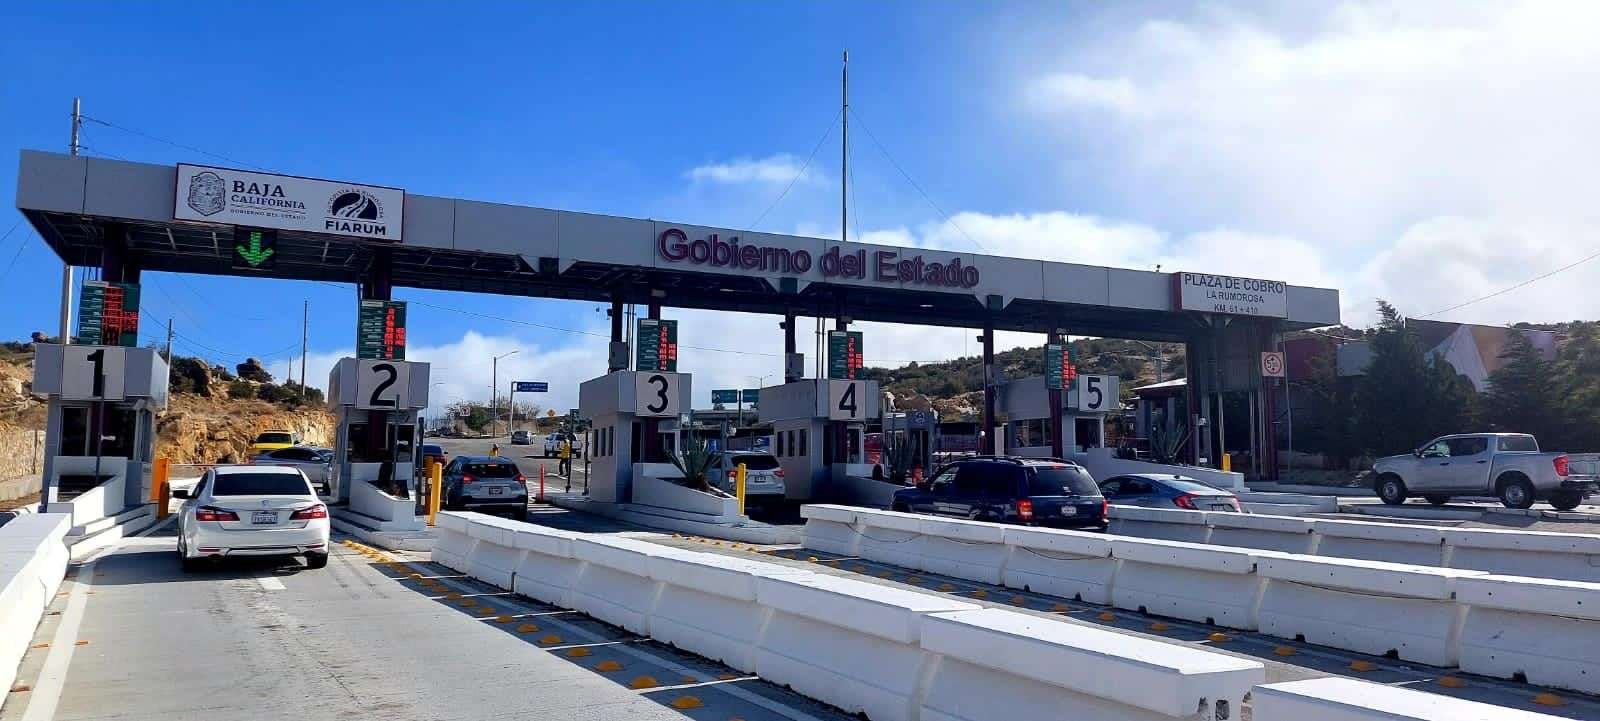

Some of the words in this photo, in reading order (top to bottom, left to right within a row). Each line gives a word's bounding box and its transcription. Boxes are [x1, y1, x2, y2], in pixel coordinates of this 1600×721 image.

[231, 195, 306, 209] CALIFORNIA
[232, 181, 285, 197] BAJA
[230, 209, 264, 217] GOBIERNO
[325, 220, 386, 236] FIARUM
[658, 228, 812, 275] Gobierno
[820, 246, 866, 279] del
[874, 250, 980, 289] Estado
[1184, 273, 1222, 288] PLAZA
[1225, 278, 1241, 290] DE
[1243, 279, 1284, 294] COBRO
[1206, 290, 1217, 299] LA
[1219, 291, 1264, 303] RUMOROSA
[87, 349, 105, 397] 1
[370, 363, 398, 406] 2
[647, 374, 669, 414] 3
[838, 382, 857, 418] 4
[1087, 377, 1103, 410] 5
